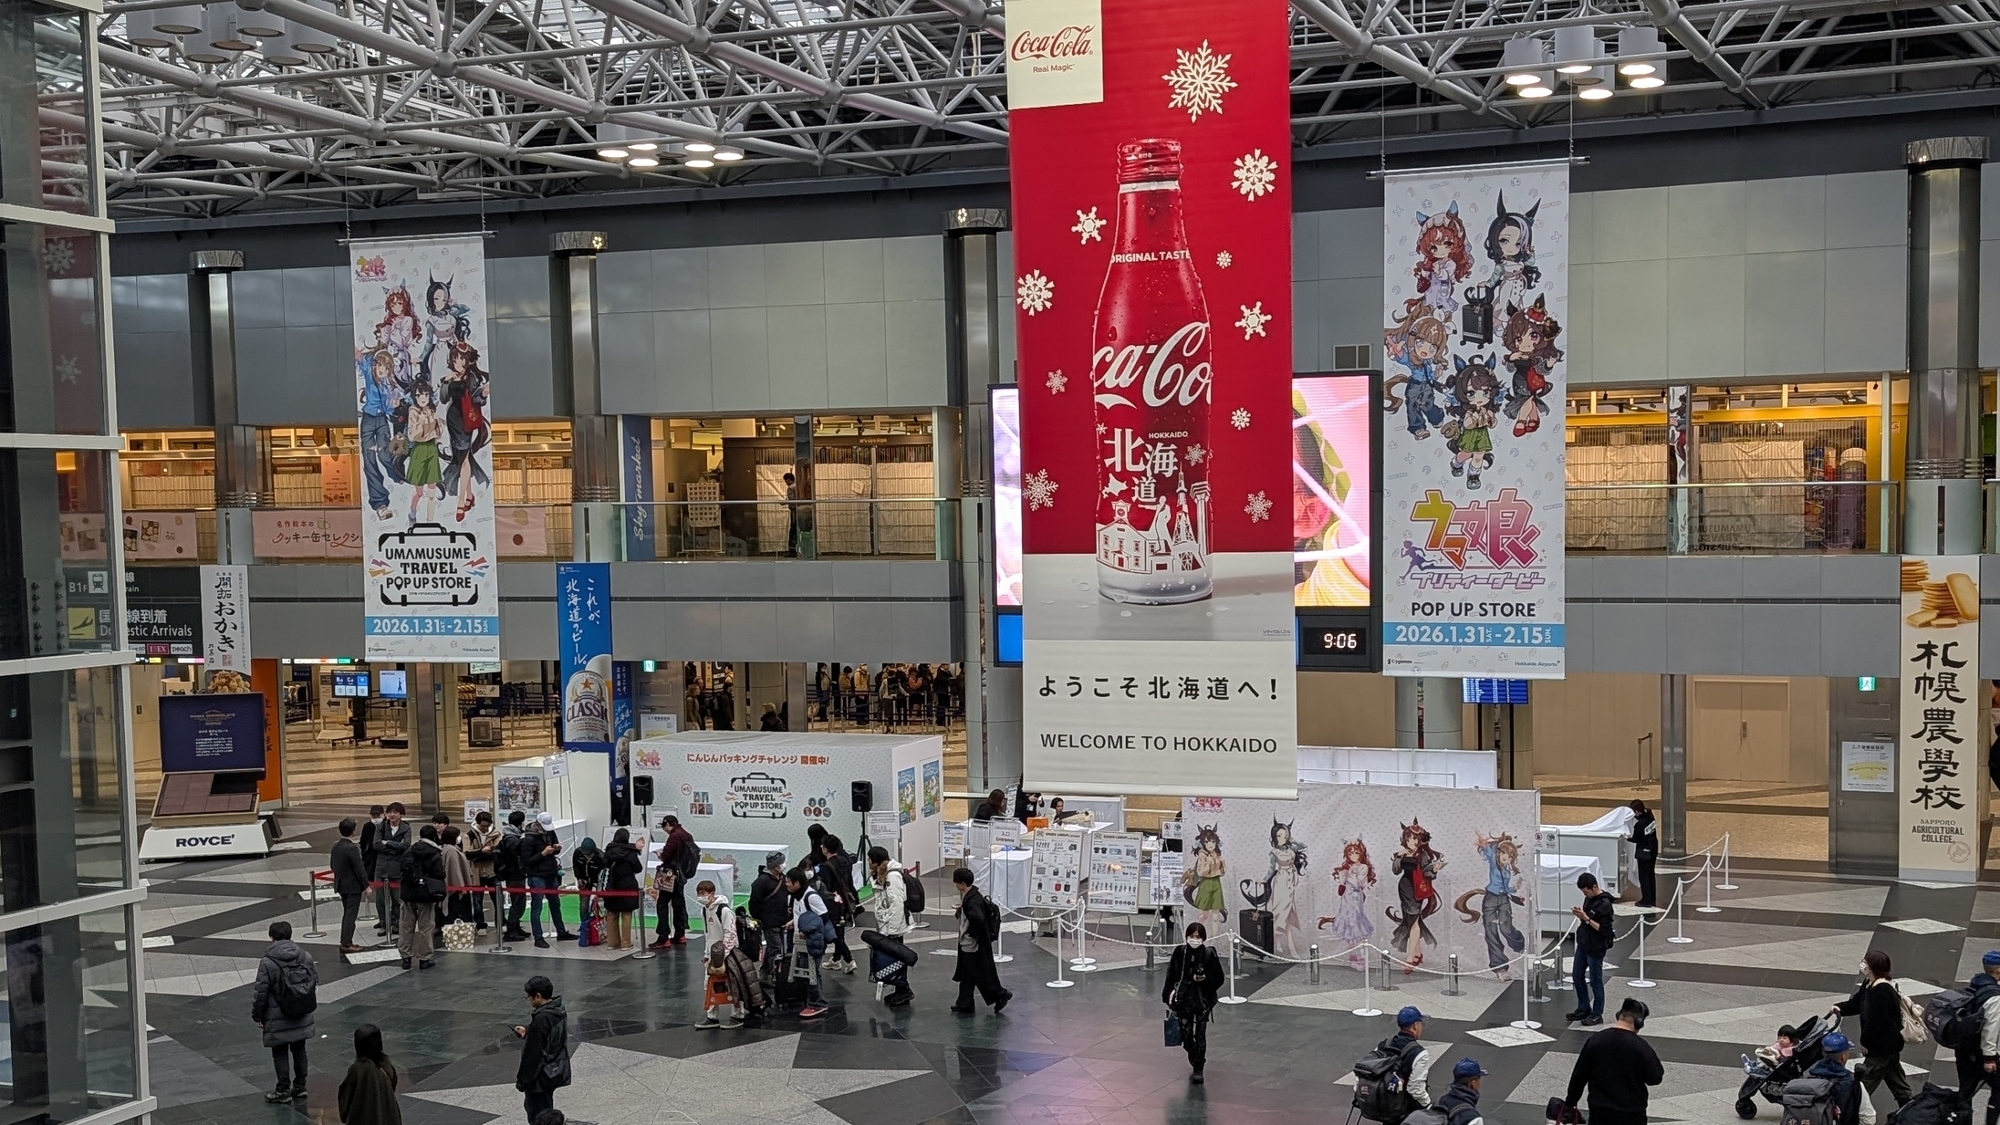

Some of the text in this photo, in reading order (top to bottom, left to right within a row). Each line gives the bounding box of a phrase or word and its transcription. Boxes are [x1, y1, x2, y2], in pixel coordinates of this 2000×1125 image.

[1011, 25, 1096, 61] Coca-Cola
[1149, 431, 1189, 439] HOKKAIDO
[276, 520, 315, 529] 名作絵本の
[385, 547, 471, 560] UMAMUSUME
[400, 562, 458, 575] TRAVEL
[69, 582, 88, 593] B1F
[386, 576, 472, 591] POP UP STORE
[1411, 572, 1546, 589] プリティーダービー
[1411, 602, 1536, 617] POP UP STORE
[151, 625, 193, 637] Arrivals
[373, 618, 440, 633] 2026.1.31
[453, 618, 483, 633] 2.15
[1324, 633, 1357, 649] 9:06
[1395, 625, 1486, 644] 2026.1.31
[1503, 627, 1543, 644] 2.15
[1039, 675, 1278, 700] ようこそ北海道へ！
[1910, 639, 1969, 811] 札幌農學校
[1041, 733, 1278, 753] WELCOME TO HOKKAIDO
[734, 801, 749, 809] POP
[1920, 818, 1957, 826] SAPPORO
[1911, 825, 1965, 836] AGRICULTURAL
[176, 834, 235, 848] ROYCE'
